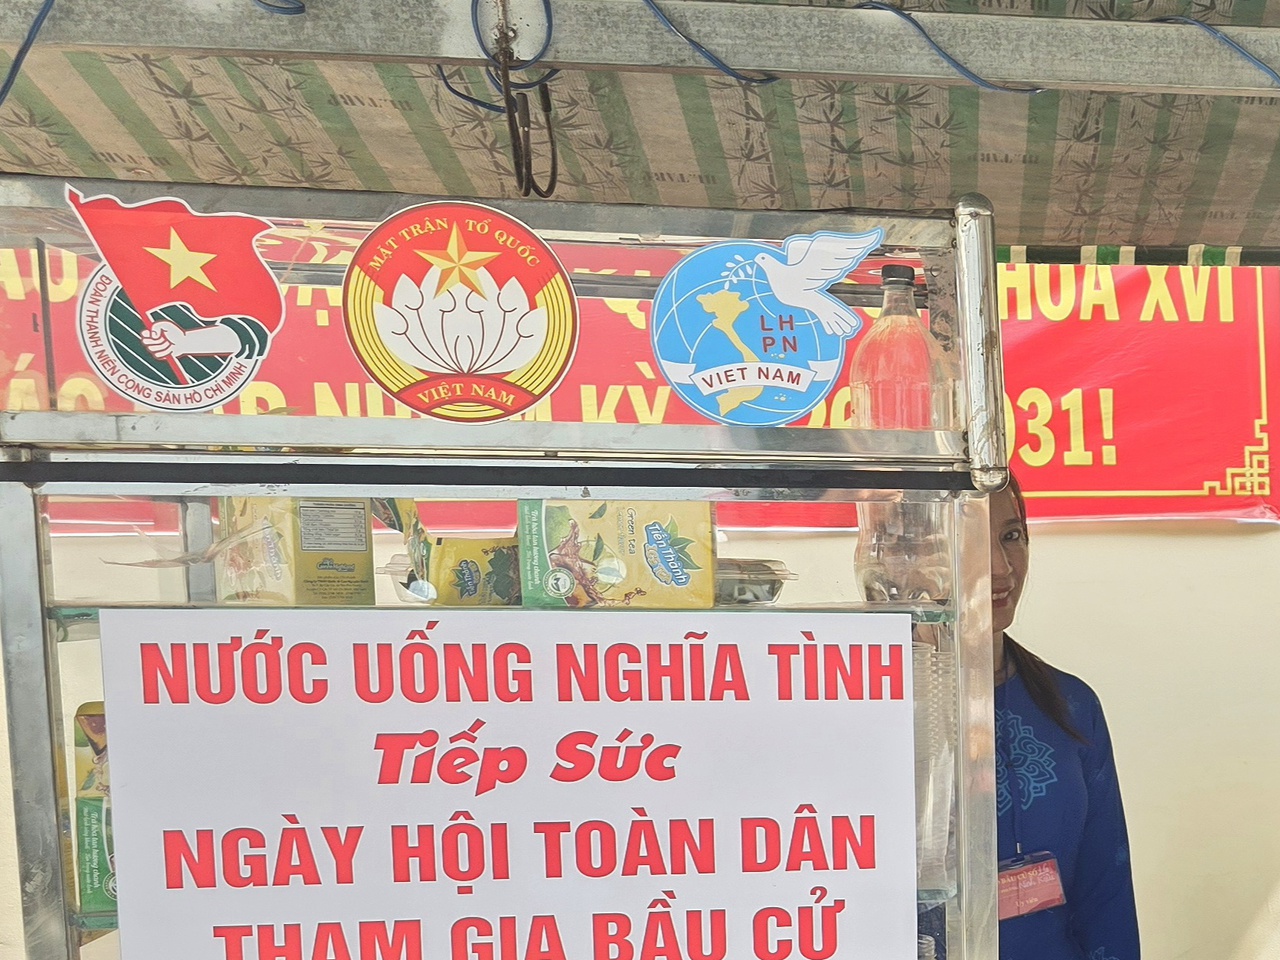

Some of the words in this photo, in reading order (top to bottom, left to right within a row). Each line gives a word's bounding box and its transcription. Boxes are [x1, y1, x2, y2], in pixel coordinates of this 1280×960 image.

[368, 237, 396, 271] MẶT
[399, 217, 449, 241] TRẬN
[465, 219, 492, 234] TỔ
[494, 230, 541, 267] QUỐC
[1140, 265, 1234, 322] XVI
[86, 310, 102, 348] THANH
[117, 374, 152, 399] CỘNG
[223, 362, 247, 388] MINH
[702, 367, 748, 389] VIET
[758, 367, 801, 386] NAM
[417, 382, 463, 404] VIỆT
[471, 383, 516, 406] NAM
[627, 508, 637, 535] Green
[628, 539, 636, 555] tea
[139, 628, 329, 706] NƯỚC
[353, 619, 533, 704] UỐNG
[555, 630, 750, 703] NGHĨA
[766, 630, 906, 702] TÌNH
[373, 718, 529, 797] Tiếp
[549, 726, 683, 783] Sức
[162, 814, 364, 891] NGÀY
[390, 810, 510, 896] HỘI
[533, 806, 715, 880] TOÀN
[740, 803, 878, 874] DÂN
